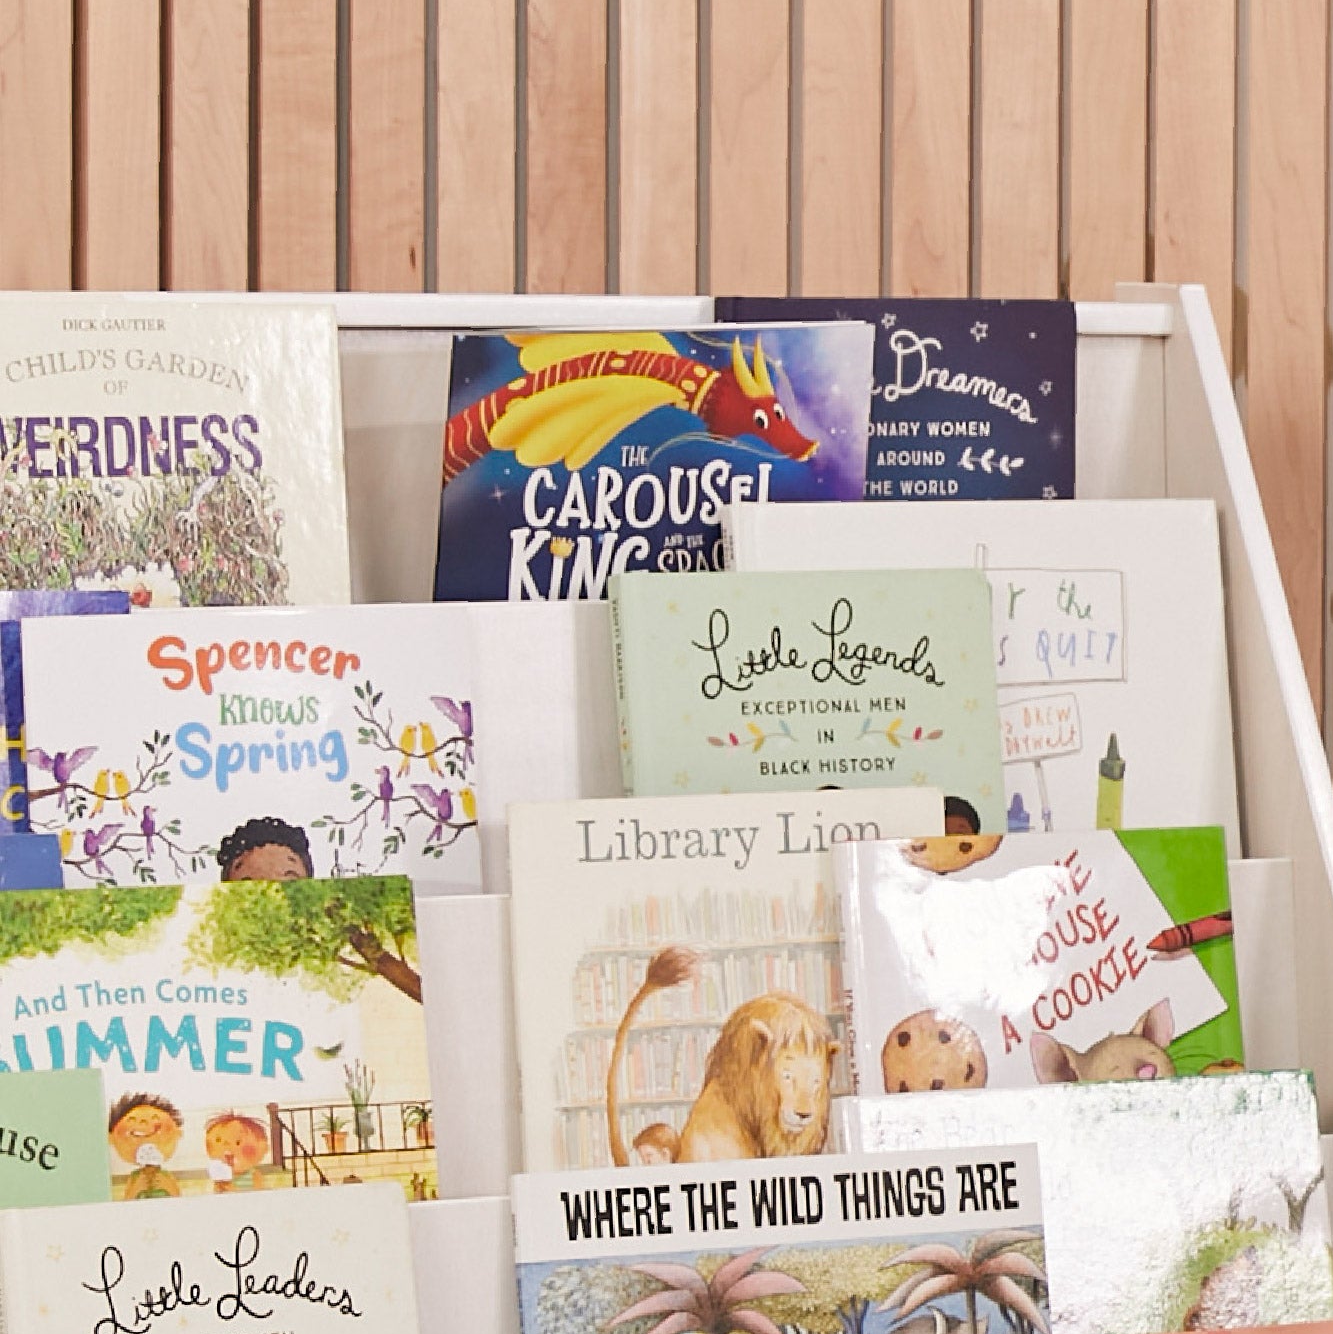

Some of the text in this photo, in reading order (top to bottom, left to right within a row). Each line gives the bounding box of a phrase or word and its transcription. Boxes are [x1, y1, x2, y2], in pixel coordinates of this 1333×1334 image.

[62, 318, 167, 332] DICK GAUTIER
[5, 348, 250, 394] CHILD'S GARDEN
[103, 379, 129, 396] OF
[884, 329, 1038, 424] Dreamers
[926, 421, 991, 437] WOMEN
[621, 445, 650, 467] THE
[876, 450, 946, 467] AROUND
[900, 479, 959, 496] WORLD
[147, 635, 361, 695] Spencer
[692, 608, 807, 699] Little
[811, 597, 946, 686] Legends
[741, 697, 907, 716] EXCEPTIONAL MEN
[175, 722, 350, 793] Spring
[817, 729, 835, 744] IN
[760, 757, 897, 776] BLACK HISTORY
[577, 818, 760, 870] Library
[14, 978, 248, 1021] And Then Comes
[1001, 936, 1149, 1055] A COOKIE
[0, 1014, 304, 1082] UMMER
[560, 1184, 673, 1242] WHERE
[680, 1180, 739, 1233] THE
[750, 1175, 823, 1229] WILD
[833, 1167, 945, 1222] THINGS
[955, 1160, 1020, 1212] ARE
[214, 1225, 362, 1321] Leaders
